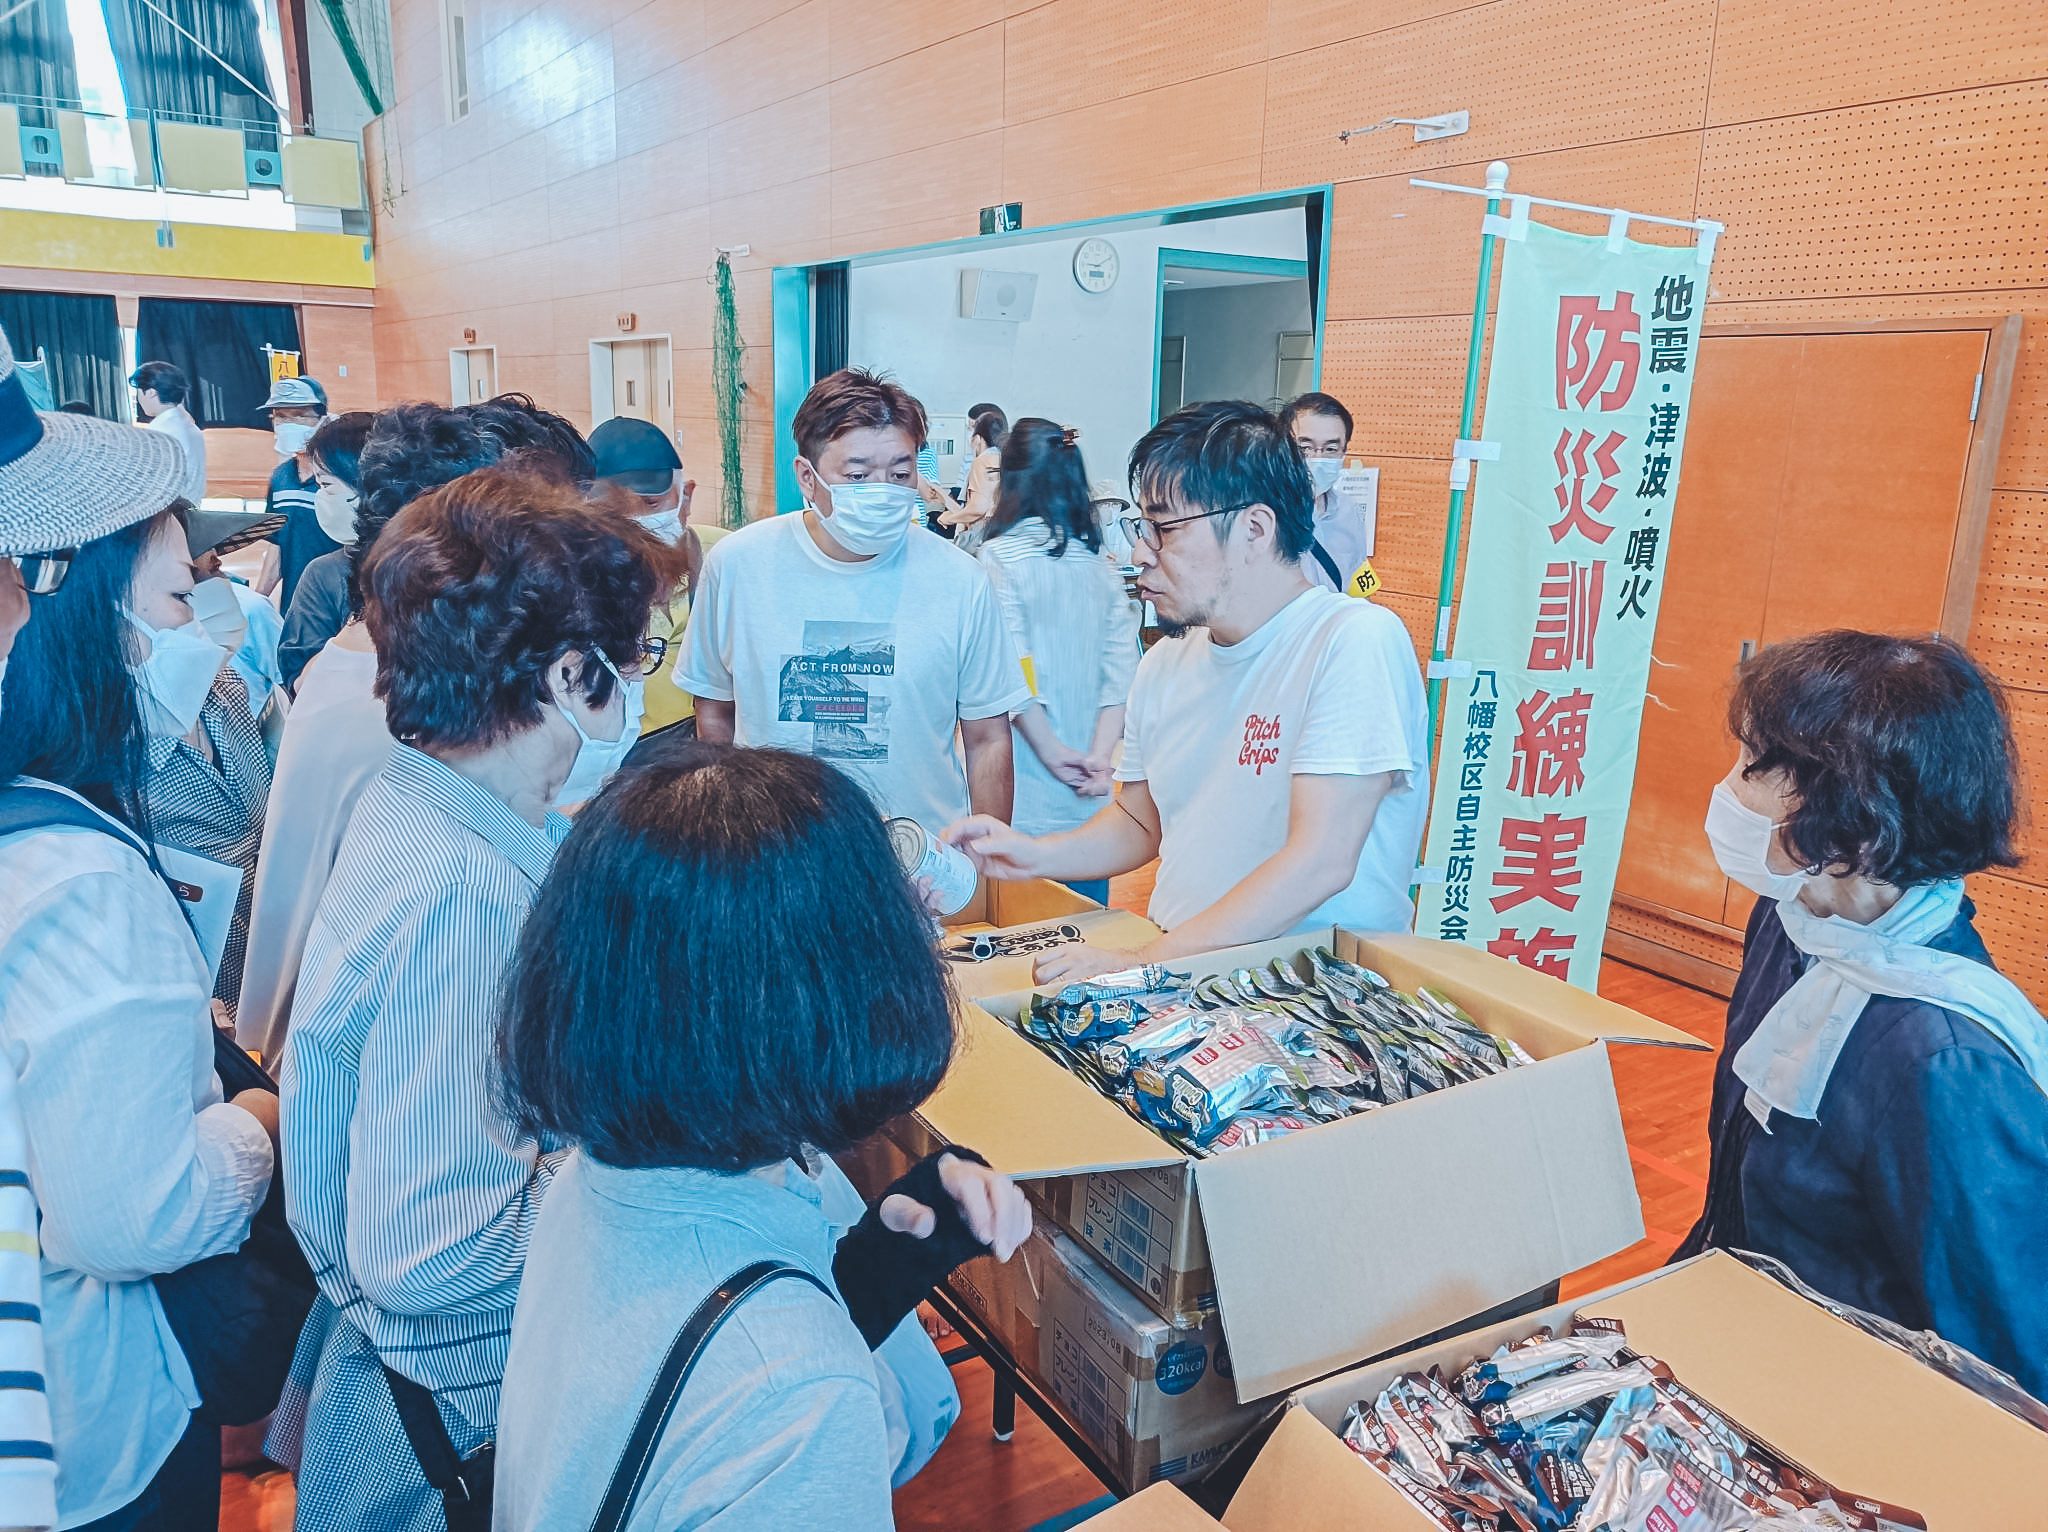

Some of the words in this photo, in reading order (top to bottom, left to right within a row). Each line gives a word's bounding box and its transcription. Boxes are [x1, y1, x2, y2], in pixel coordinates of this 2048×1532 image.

[1616, 274, 1694, 621] 地震・津波・噴火
[1356, 570, 1376, 593] 防
[790, 662, 817, 672] ACT
[822, 662, 857, 673] FROM
[863, 663, 894, 674] NOW
[1243, 714, 1281, 742] Pitch
[1238, 741, 1280, 776] Grips
[1439, 670, 1498, 941] 八幡校区自主防災会
[1159, 1357, 1205, 1381] 320kcal
